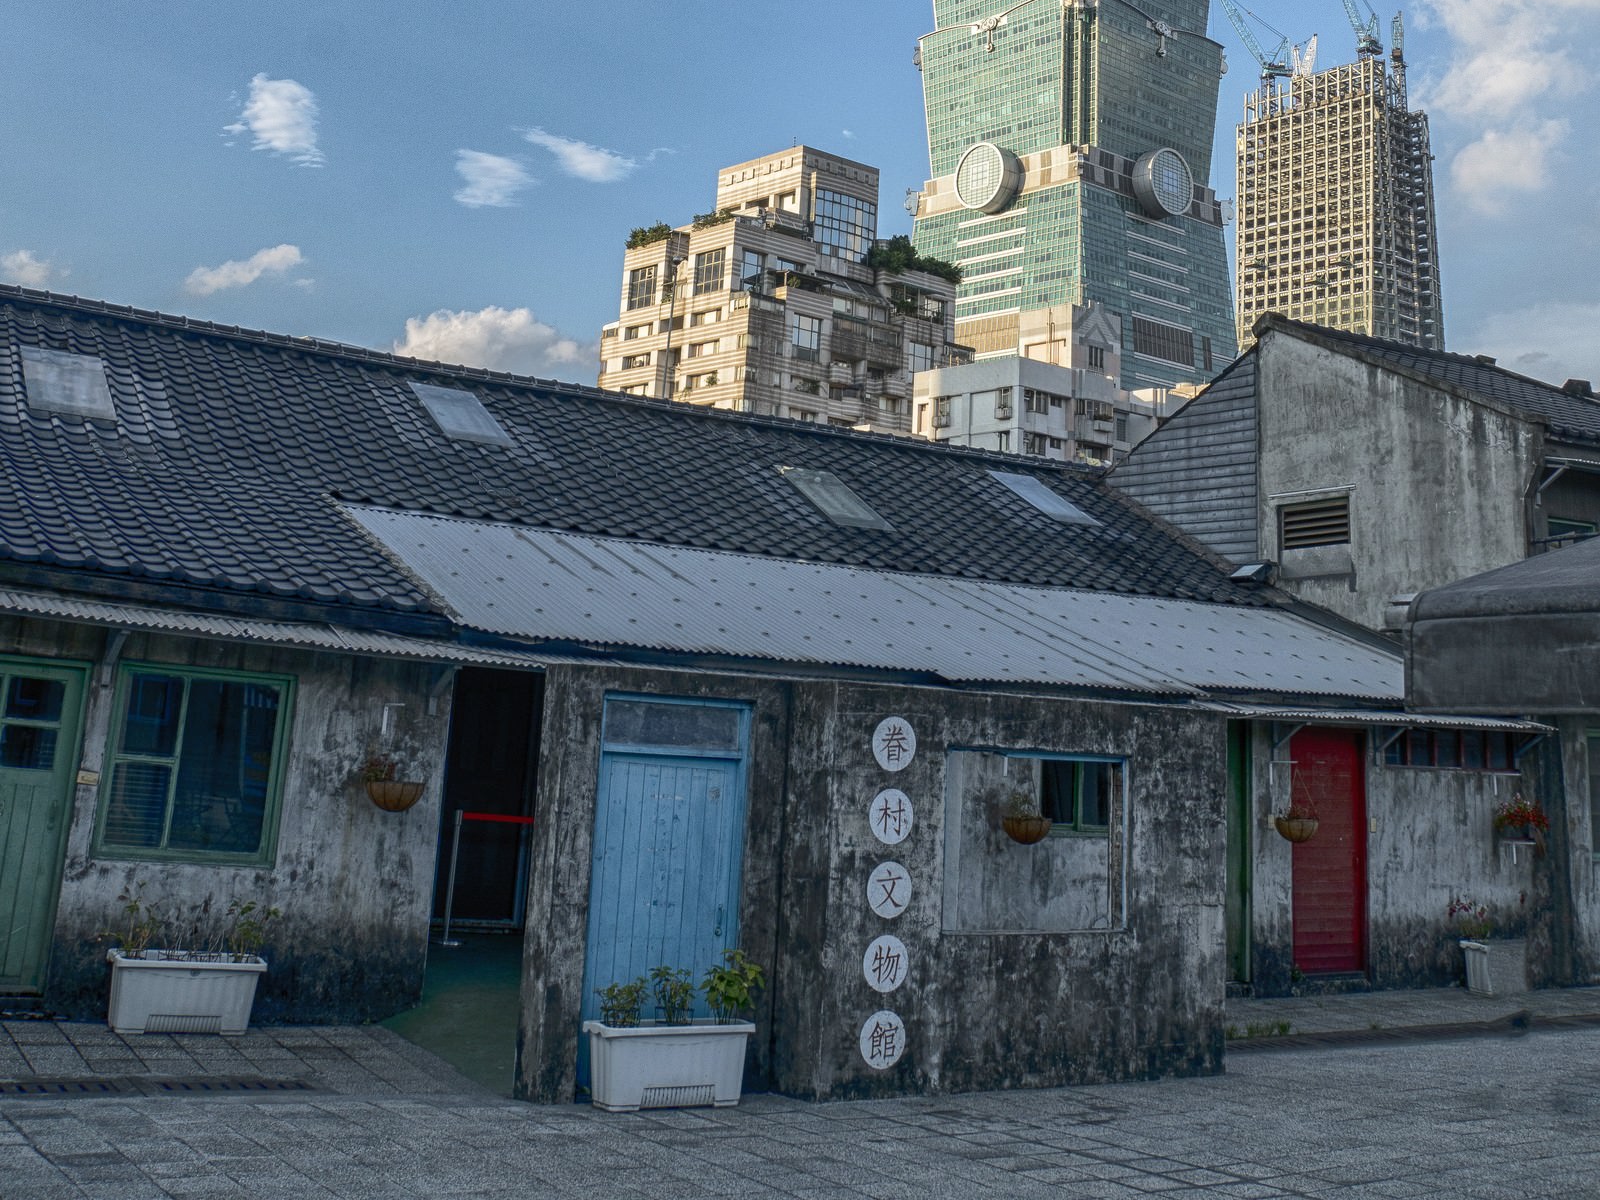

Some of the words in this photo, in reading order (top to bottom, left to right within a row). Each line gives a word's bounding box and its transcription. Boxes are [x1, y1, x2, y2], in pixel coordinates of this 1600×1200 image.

[868, 724, 909, 1060] 眷村文物館
